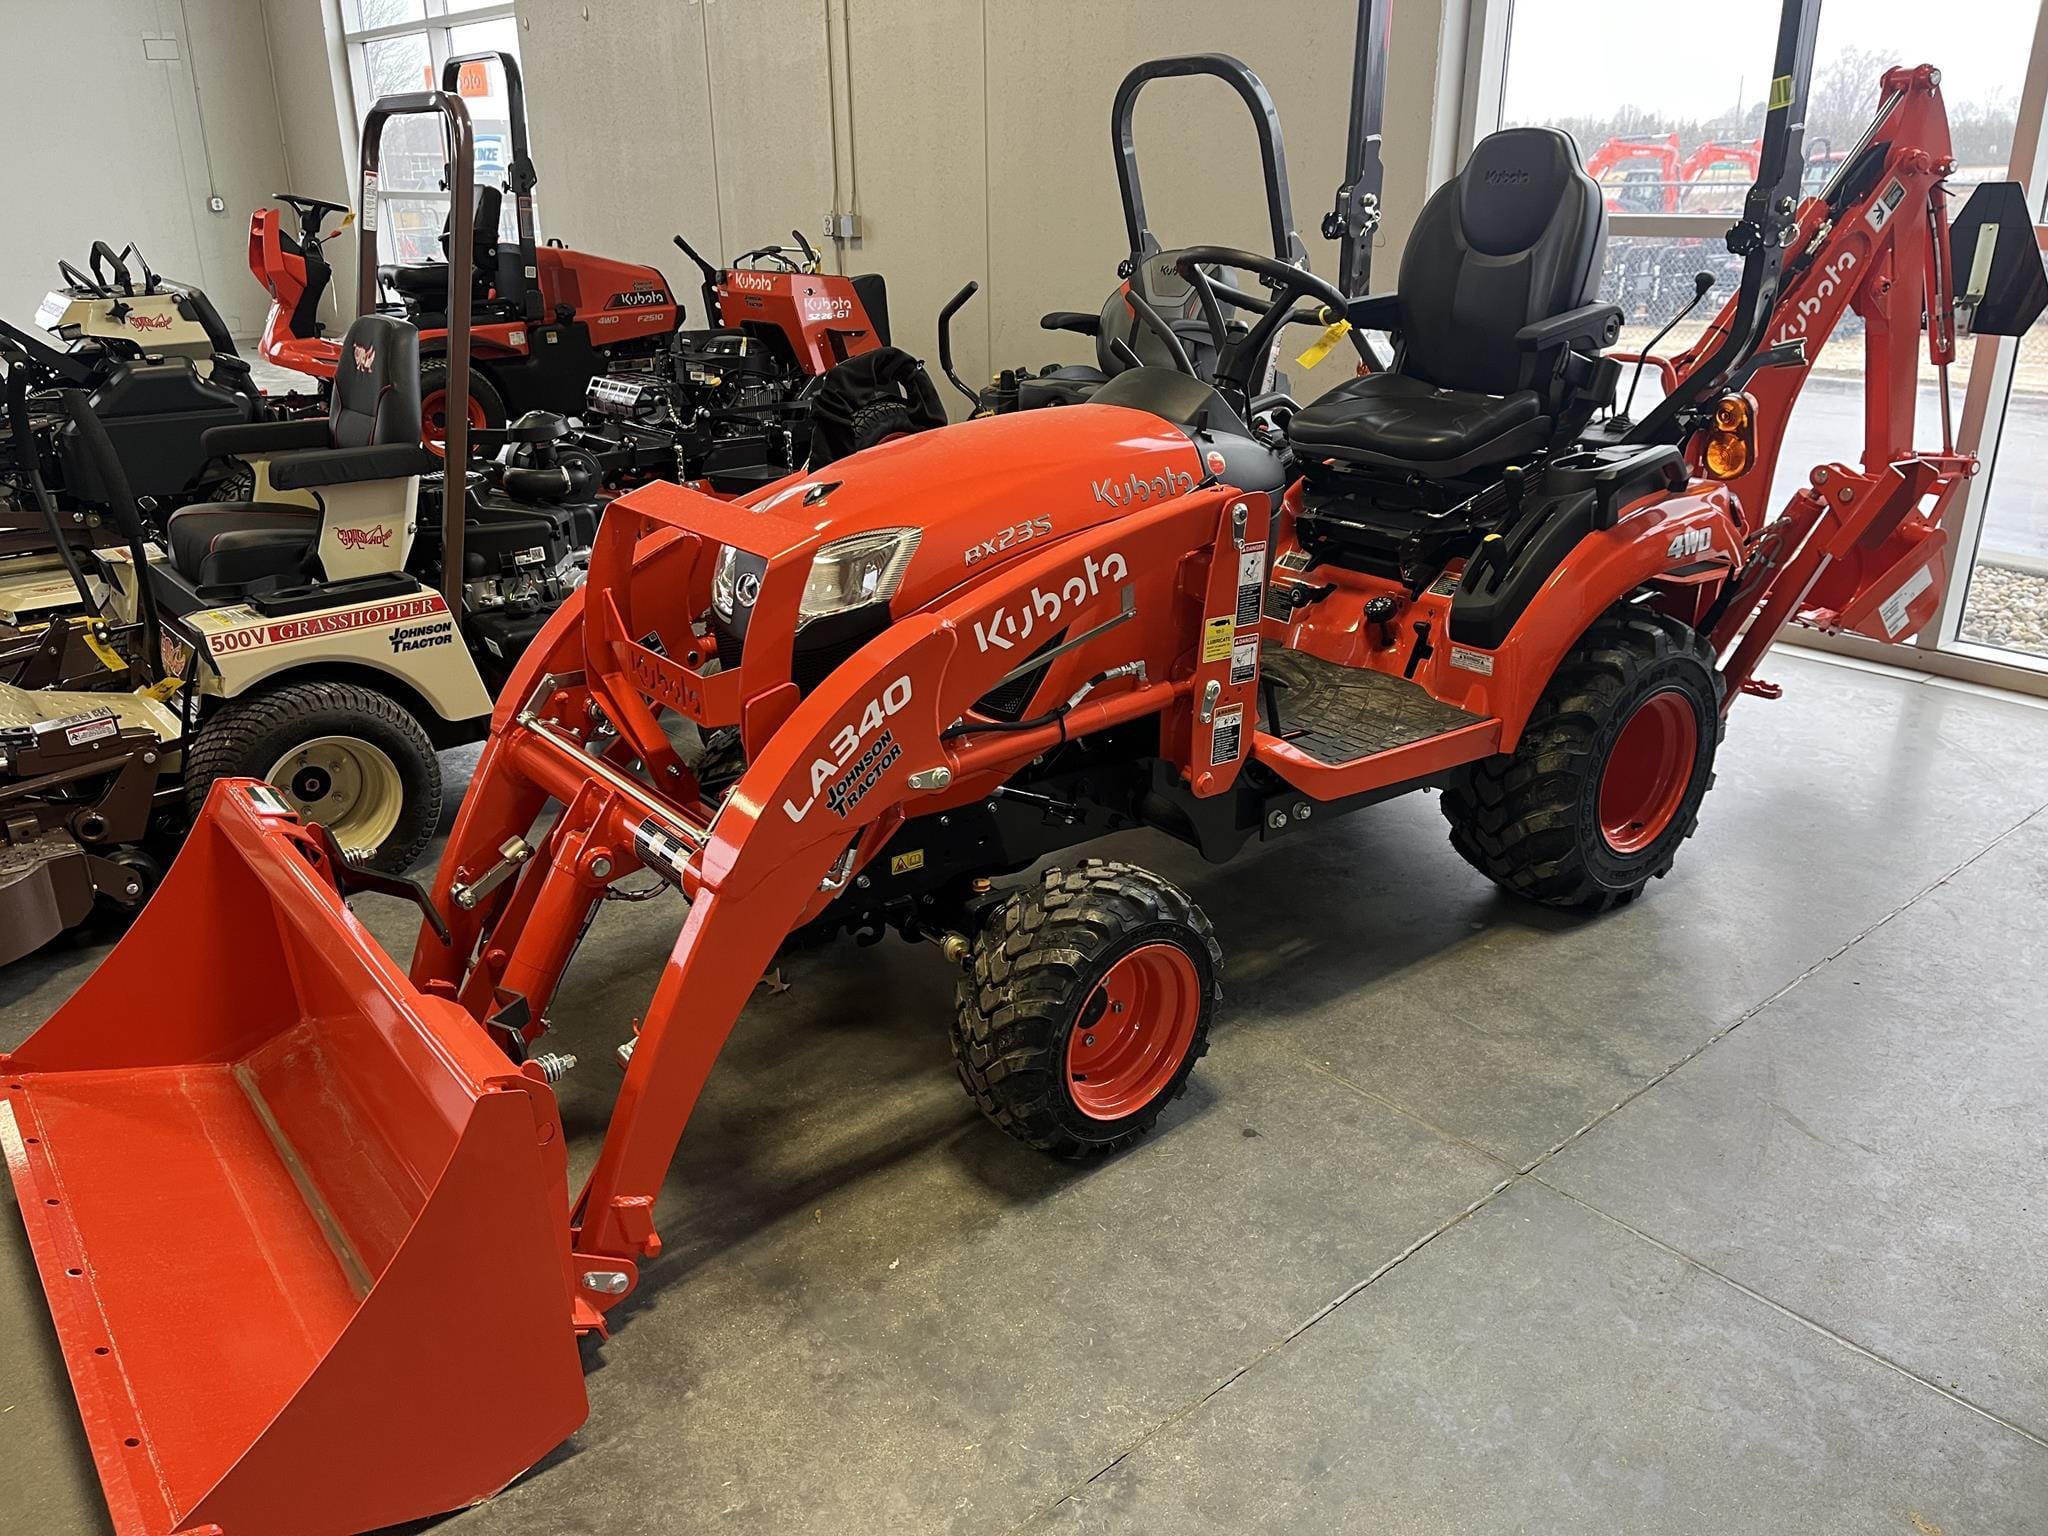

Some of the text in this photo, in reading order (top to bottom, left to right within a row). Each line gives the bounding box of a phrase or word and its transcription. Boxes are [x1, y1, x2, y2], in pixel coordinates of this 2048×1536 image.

[474, 147, 498, 161] INZE
[735, 272, 772, 291] Kubota
[621, 291, 664, 306] Kubota
[804, 296, 852, 310] Kubota
[597, 316, 620, 324] 4WD
[637, 313, 664, 323] F2510
[1091, 466, 1195, 508] Kubota
[964, 513, 1053, 567] BX23S
[1666, 526, 1712, 559] 4WD
[973, 552, 1129, 653] Kubota
[278, 599, 434, 640] GRASSHOPPER
[389, 622, 452, 642] JOHNSON
[211, 627, 266, 653] 500V
[391, 634, 453, 653] TRACTOR
[783, 675, 912, 823] LA340
[826, 729, 893, 808] JOHNSON
[833, 744, 902, 819] TRACTOR
